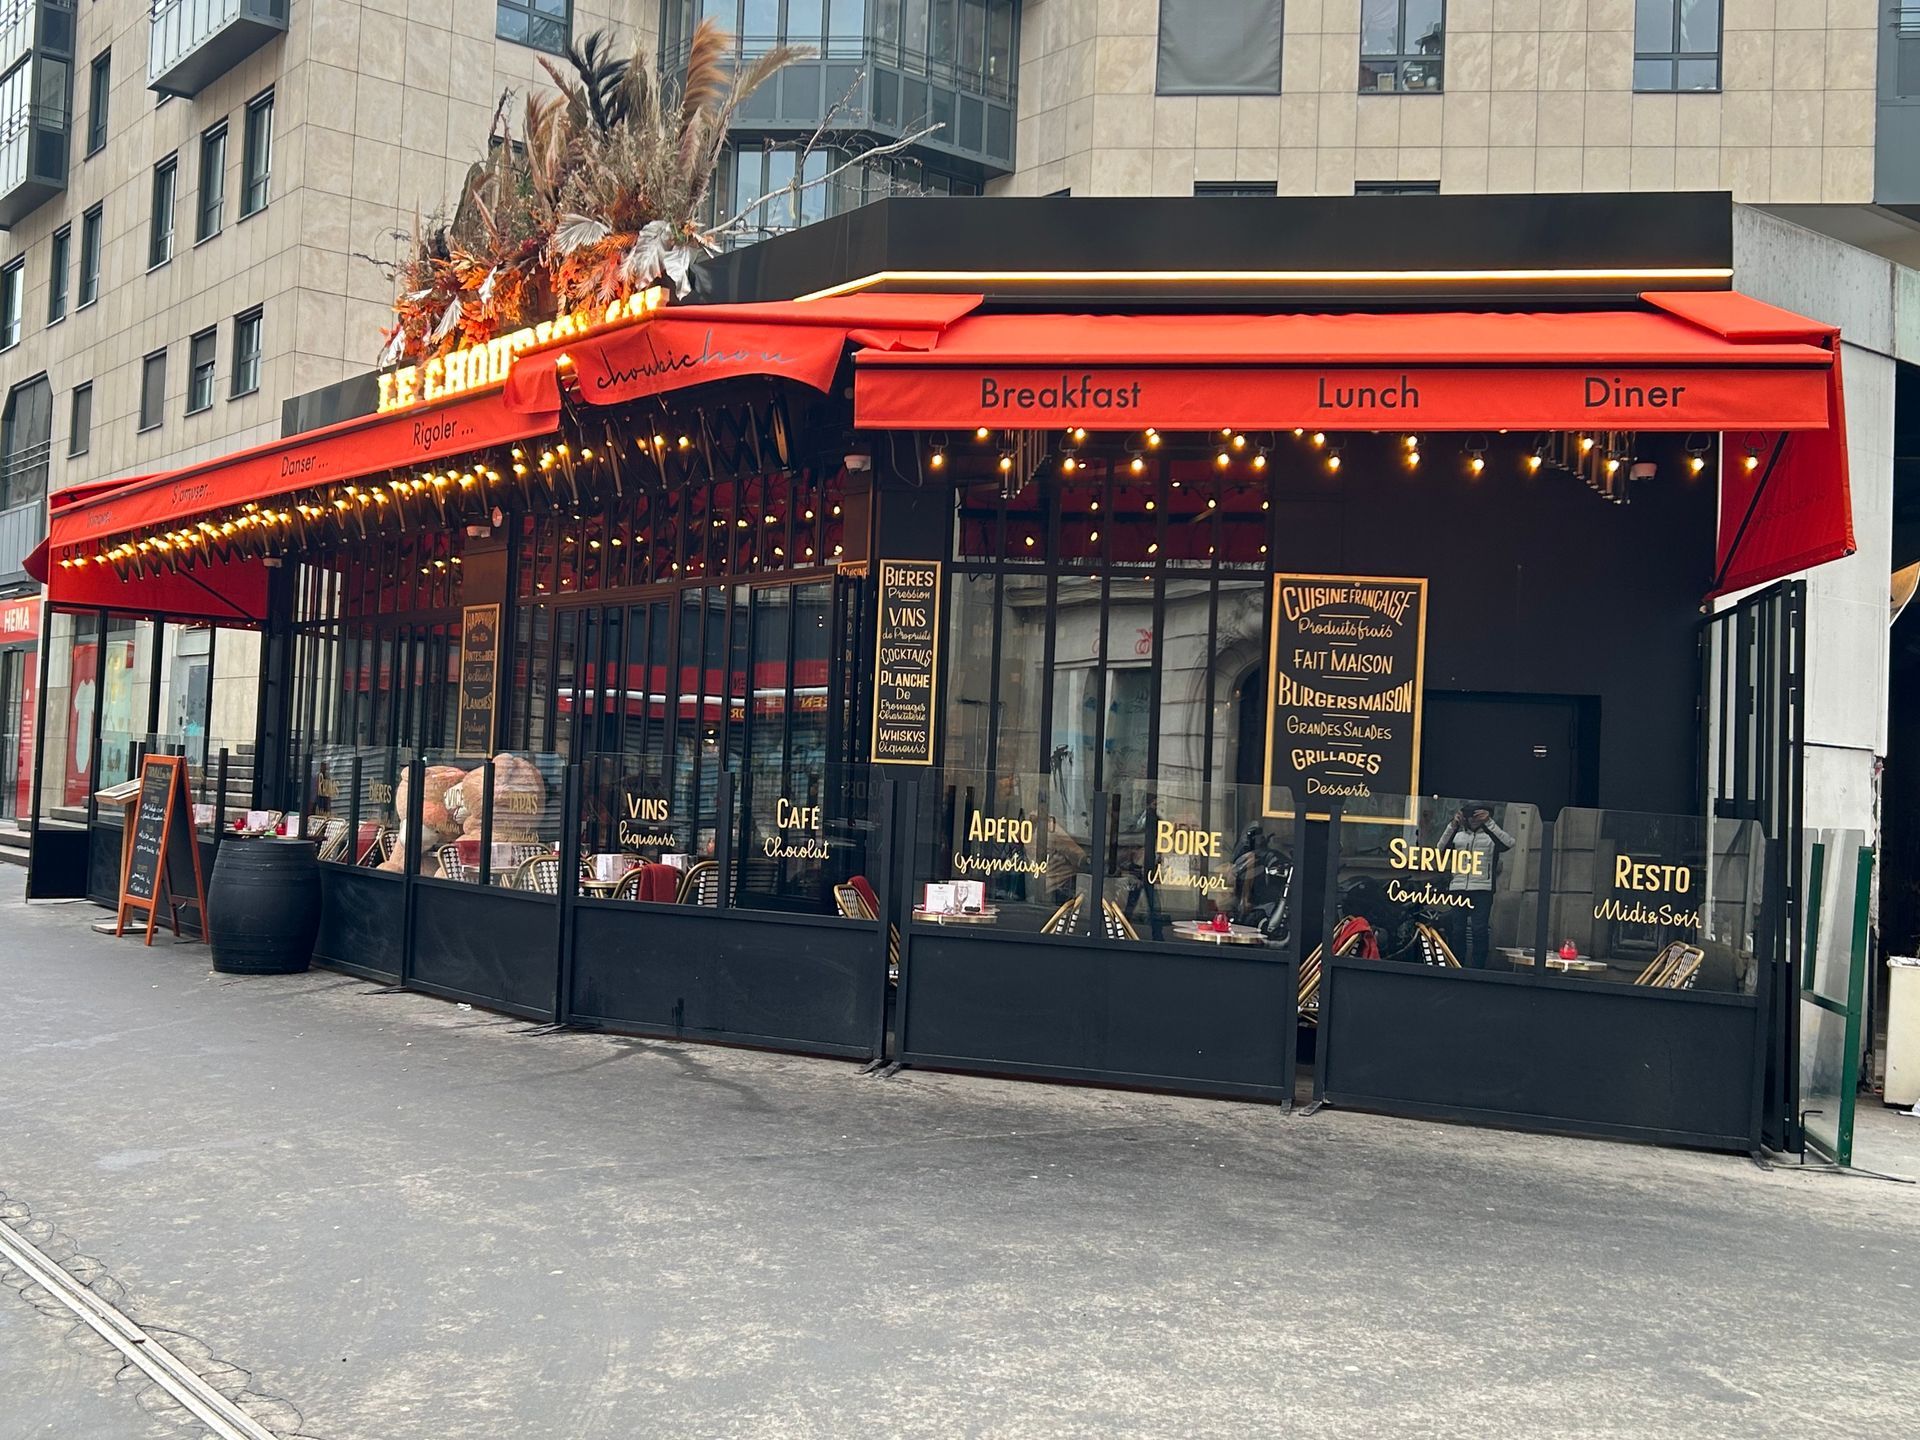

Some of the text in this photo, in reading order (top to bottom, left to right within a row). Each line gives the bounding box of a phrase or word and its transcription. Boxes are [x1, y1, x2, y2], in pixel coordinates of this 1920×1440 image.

[377, 365, 417, 413] LE
[981, 376, 1142, 409] Breakfast
[1318, 375, 1419, 409] Lunch
[1585, 377, 1686, 408] Diner
[413, 412, 458, 451] Rigoler
[281, 455, 317, 478] Danser
[888, 586, 931, 600] Pression
[1282, 586, 1417, 626] CUISINE FRANÇAISE
[4, 606, 30, 633] HEMA
[888, 607, 926, 627] VINS
[1298, 617, 1393, 640] Produits frais
[881, 647, 932, 668] COCKTAILS
[1292, 648, 1393, 675] FAIT MAISON
[880, 670, 930, 688] PLANCHE
[1277, 671, 1413, 713] BURGERS MAISON
[880, 699, 926, 713] Fromages
[896, 687, 911, 700] De
[879, 727, 926, 743] WHISKYS
[1286, 715, 1392, 740] GRANDES SALADES
[1291, 749, 1382, 775] GRILLADES
[1307, 777, 1371, 798] Desserts
[627, 793, 669, 821] VINS
[777, 798, 821, 830] CAFÉ
[968, 809, 1033, 844] APÉRO
[1156, 820, 1222, 858] BOIRE
[763, 837, 830, 860] Chocolat
[1389, 838, 1485, 875] SERVICE
[1148, 862, 1228, 897] Manger
[1614, 855, 1691, 894] RESTO
[1387, 879, 1475, 909] Continu
